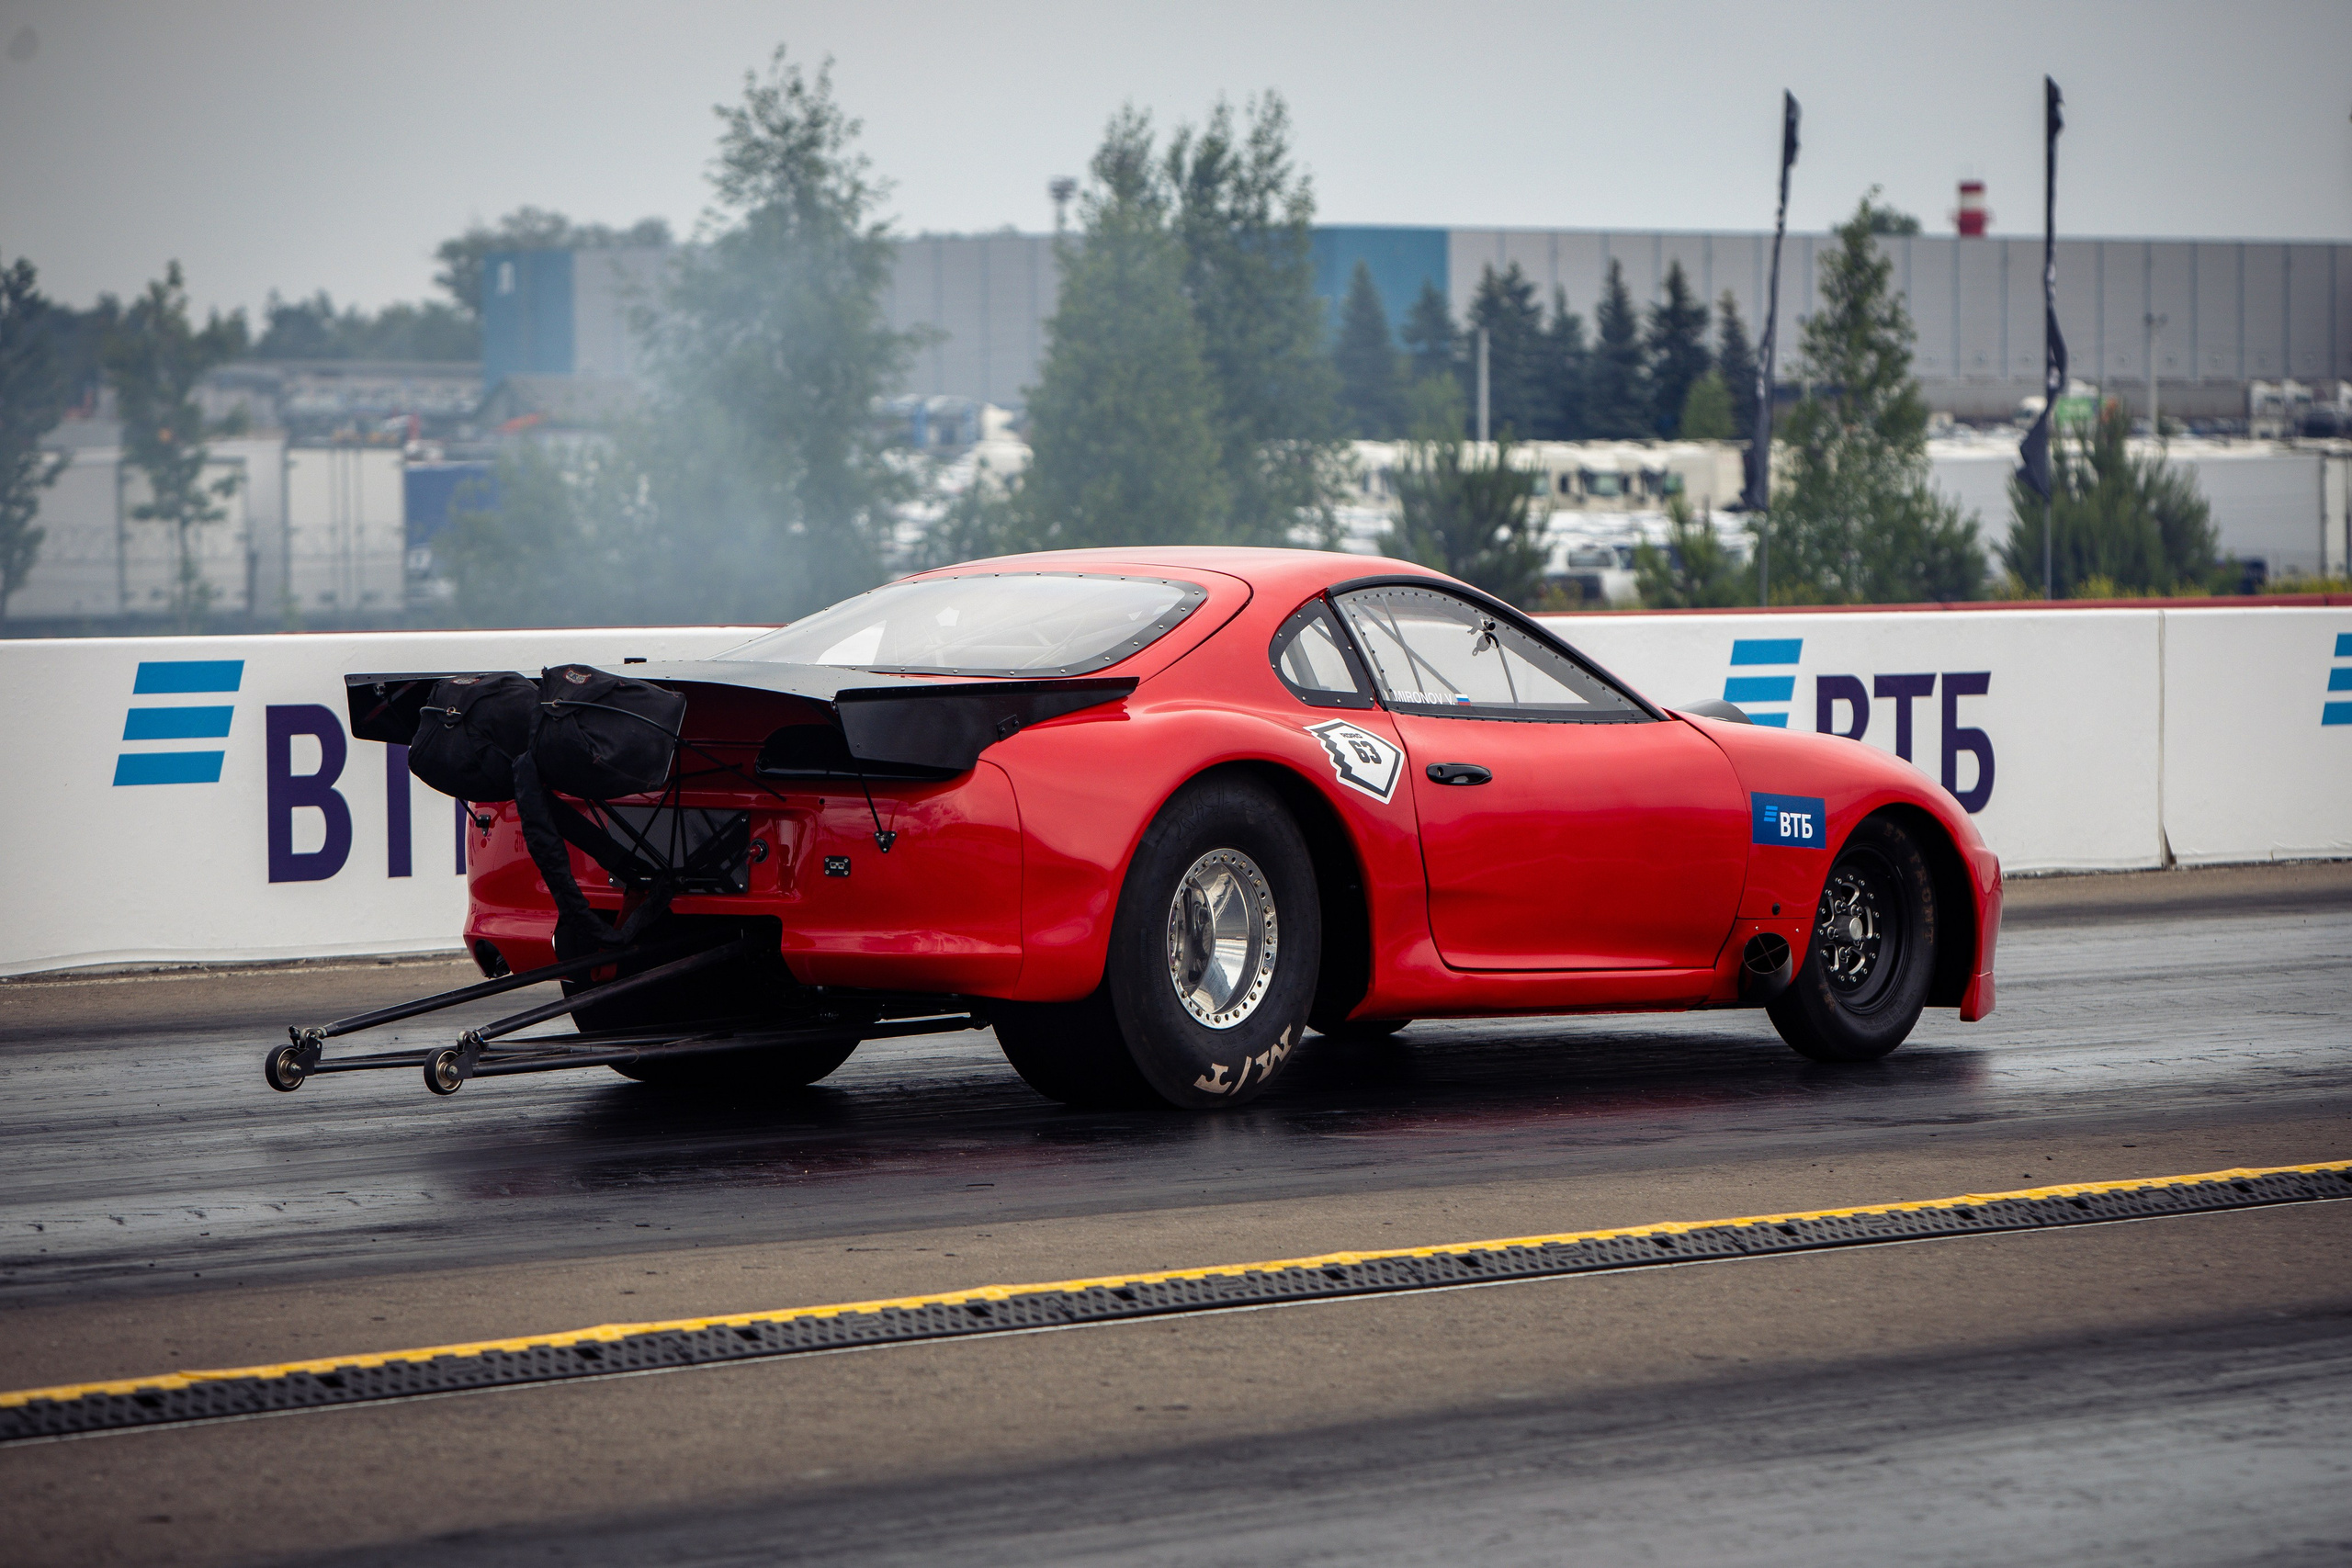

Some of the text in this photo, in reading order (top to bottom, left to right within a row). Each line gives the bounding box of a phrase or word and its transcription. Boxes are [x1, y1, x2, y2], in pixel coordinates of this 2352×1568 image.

[1394, 690, 1455, 705] MIRONOV V.
[1349, 740, 1382, 763] 63
[1780, 811, 1814, 840] ВТБ
[1909, 852, 1934, 946] FRONT
[1193, 1023, 1292, 1097] M/T
